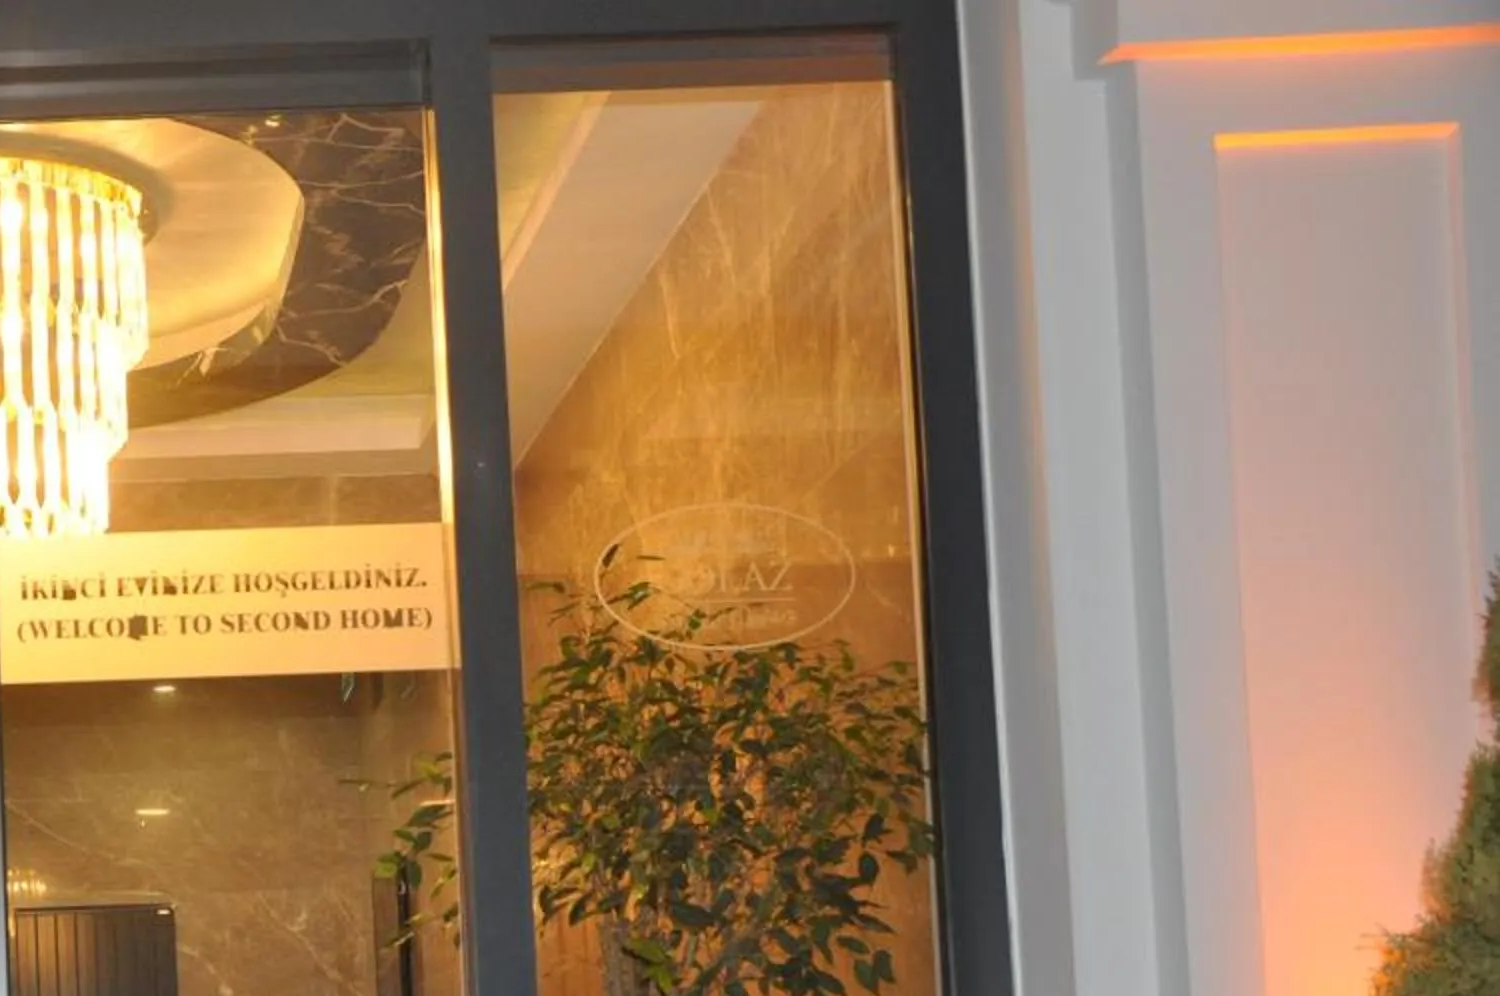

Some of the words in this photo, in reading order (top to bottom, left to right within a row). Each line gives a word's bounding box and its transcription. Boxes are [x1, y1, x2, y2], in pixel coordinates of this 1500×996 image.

[234, 563, 428, 598] HOŞGELDİNİZ.
[176, 613, 213, 636] TO
[219, 610, 331, 634] SECOND
[340, 607, 433, 630] HOME)
